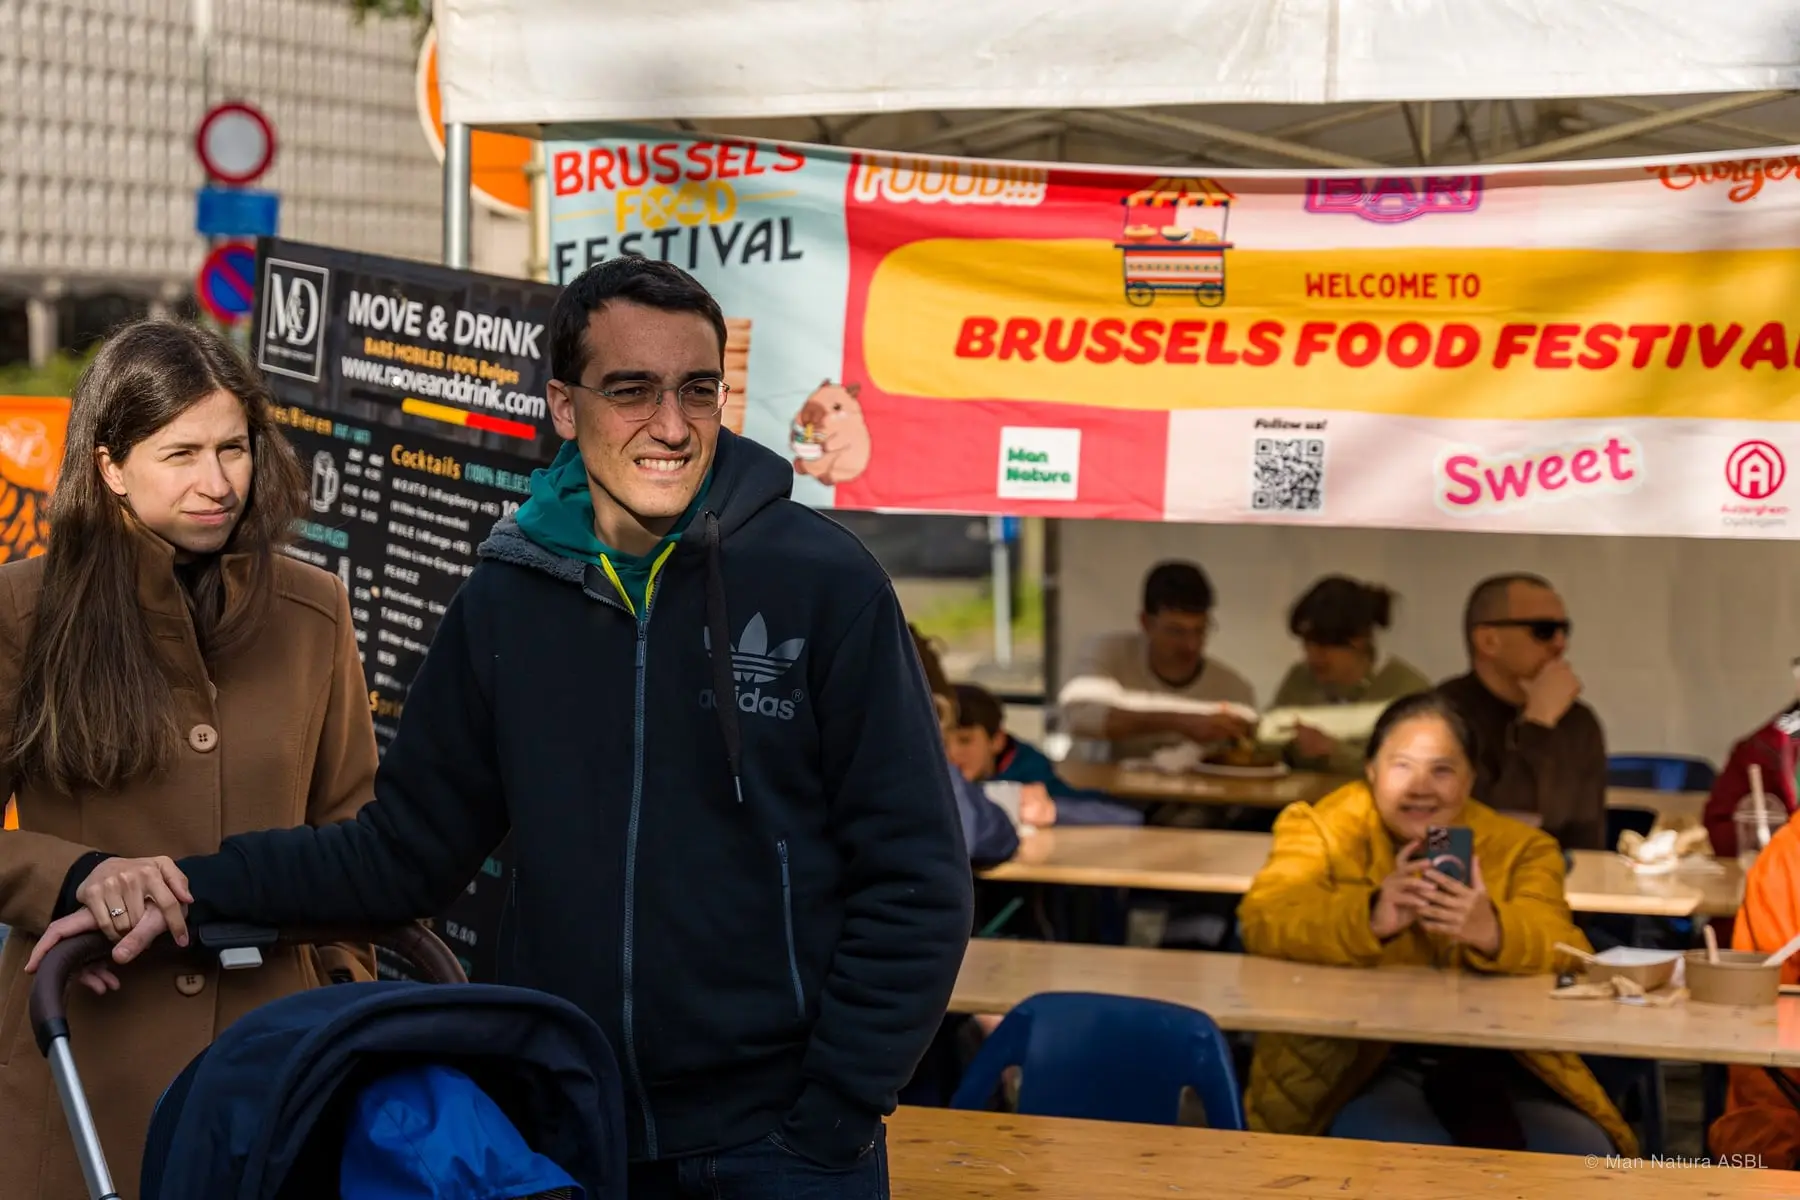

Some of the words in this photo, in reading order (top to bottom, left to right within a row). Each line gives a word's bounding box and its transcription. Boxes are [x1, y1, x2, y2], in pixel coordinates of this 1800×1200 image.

[554, 140, 807, 196] BRUSSELS
[615, 180, 738, 233] FOOD
[1305, 273, 1438, 299] WELCOME
[1448, 273, 1481, 299] TO
[348, 290, 424, 337] MOVE
[426, 305, 449, 342] &
[453, 310, 545, 360] DRINK
[955, 317, 1286, 367] BRUSSELS
[1294, 322, 1482, 368] FOOD
[1492, 321, 1800, 370] FESTIVA
[341, 356, 546, 420] www.moveanddrink.com
[1255, 418, 1301, 431] Follow
[390, 444, 461, 480] Cocktails
[1006, 467, 1071, 484] Natura
[1007, 447, 1048, 463] Man
[1445, 438, 1634, 505] Sweet
